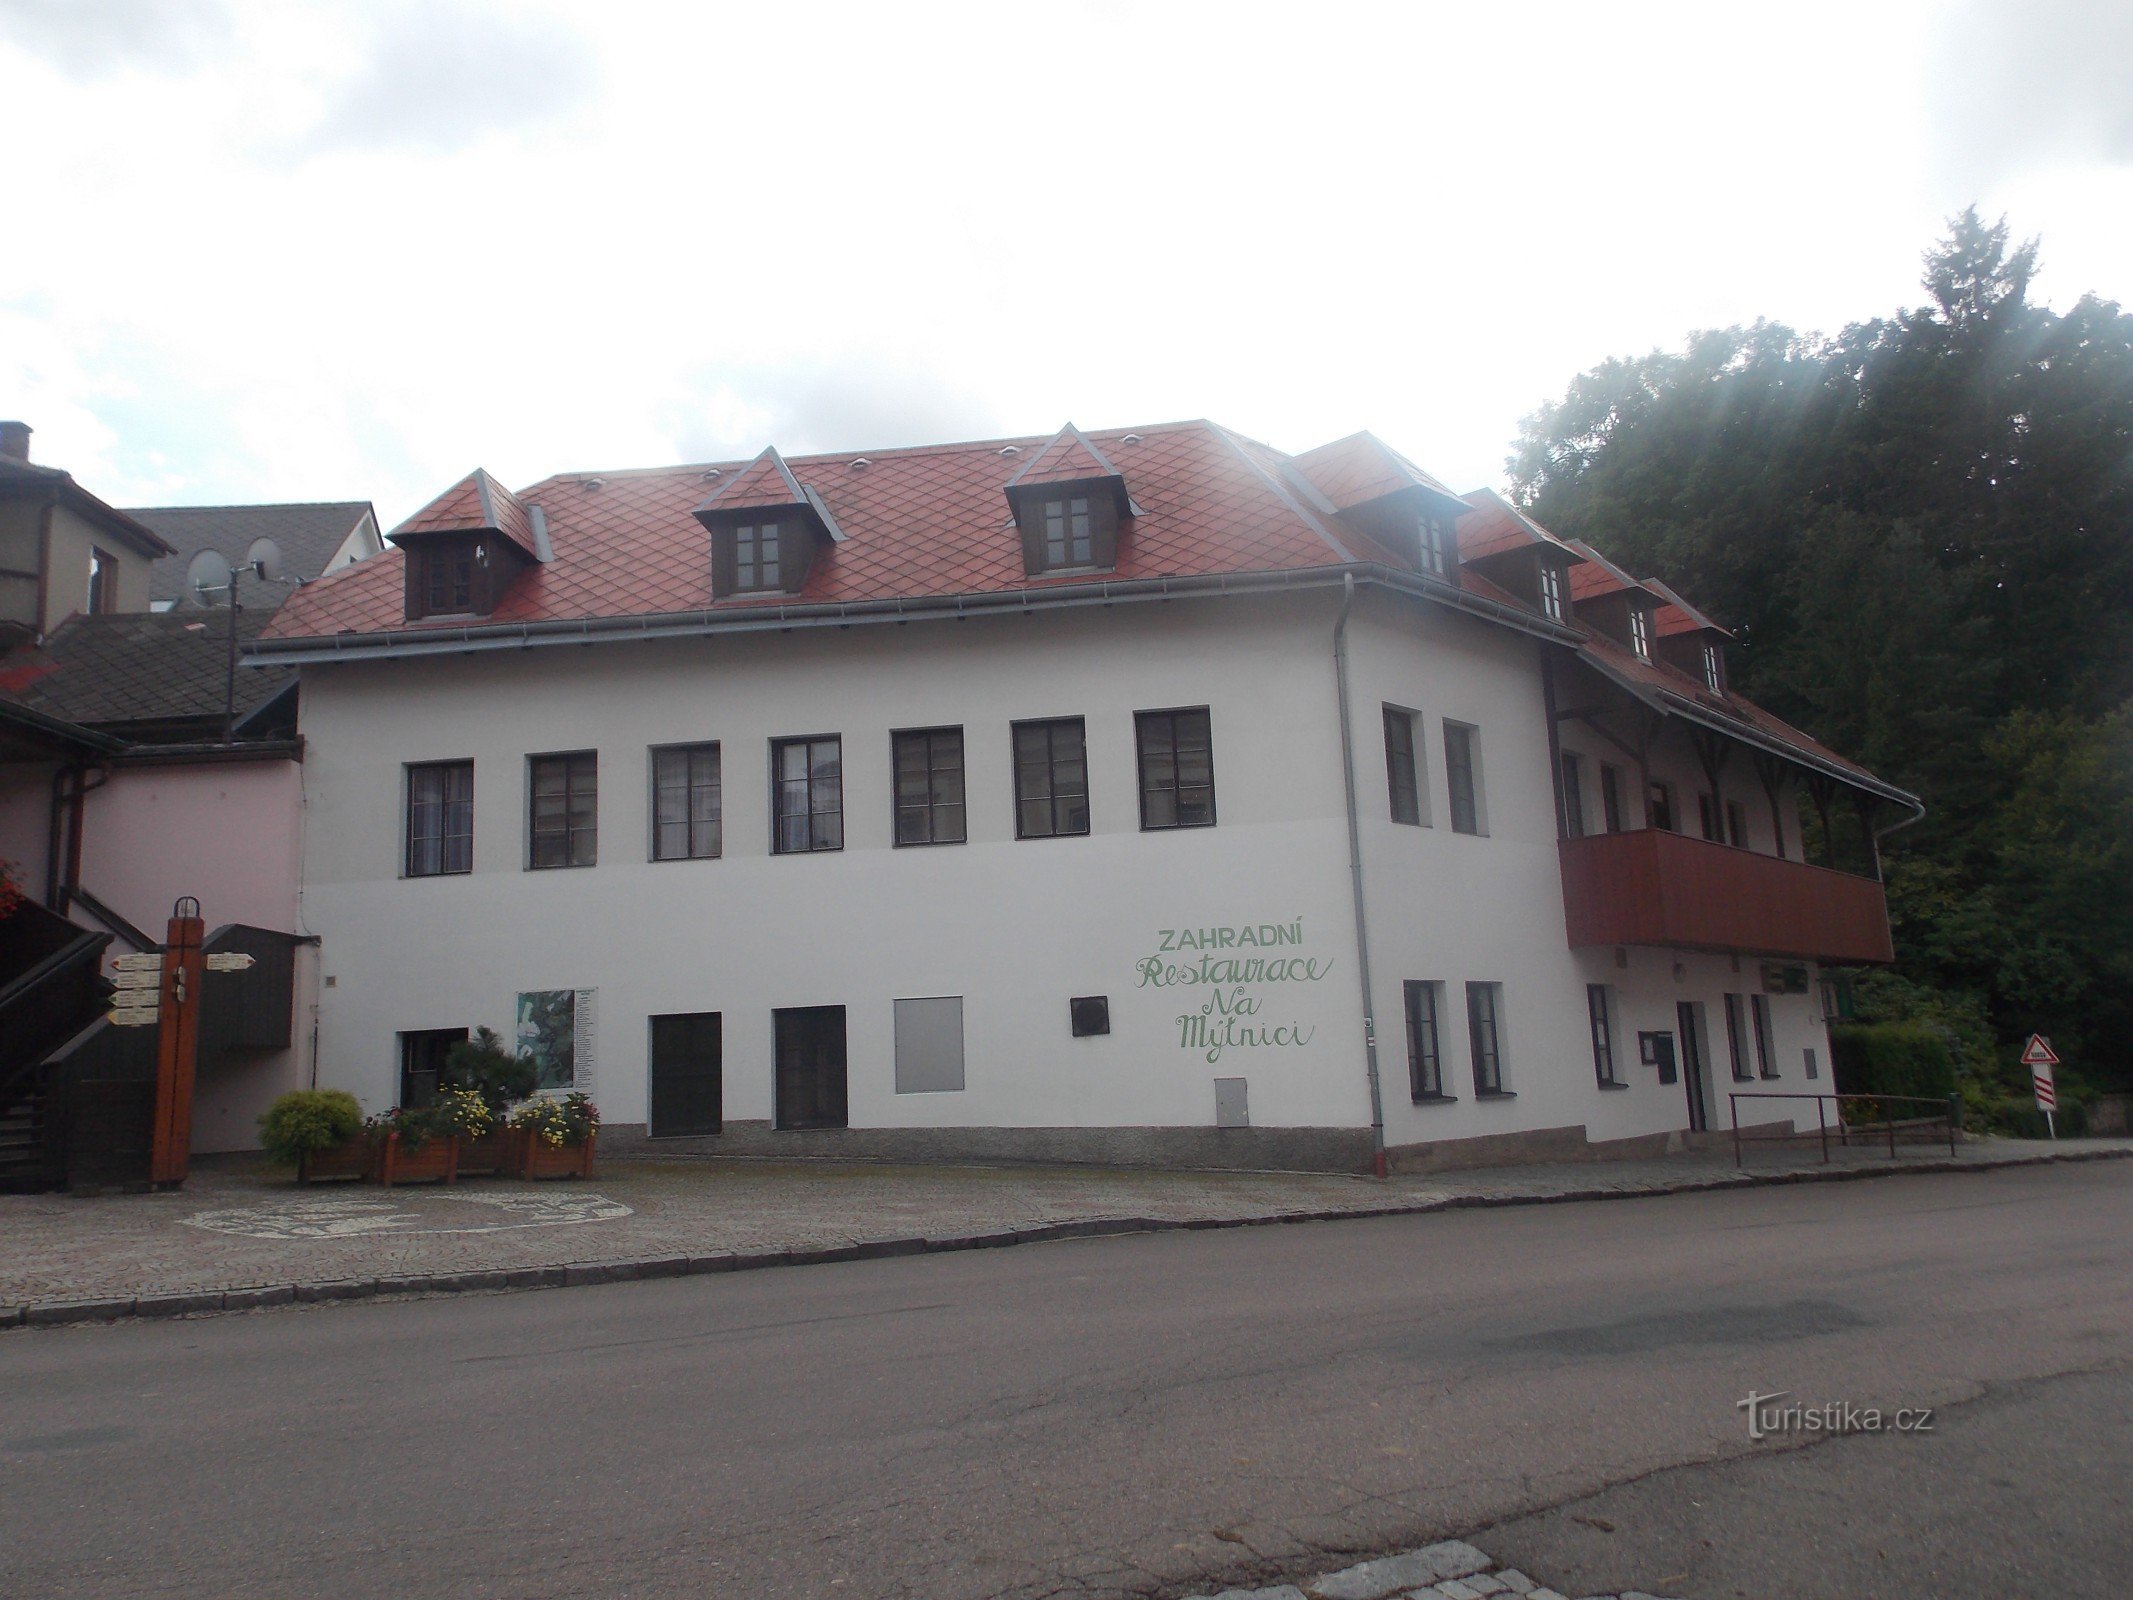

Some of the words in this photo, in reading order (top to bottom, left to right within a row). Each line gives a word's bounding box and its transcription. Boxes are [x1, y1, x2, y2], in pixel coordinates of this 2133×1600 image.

[1158, 916, 1303, 951] ZAHRADNÍ
[1134, 954, 1335, 988] Restaurace
[1202, 986, 1263, 1015] Na
